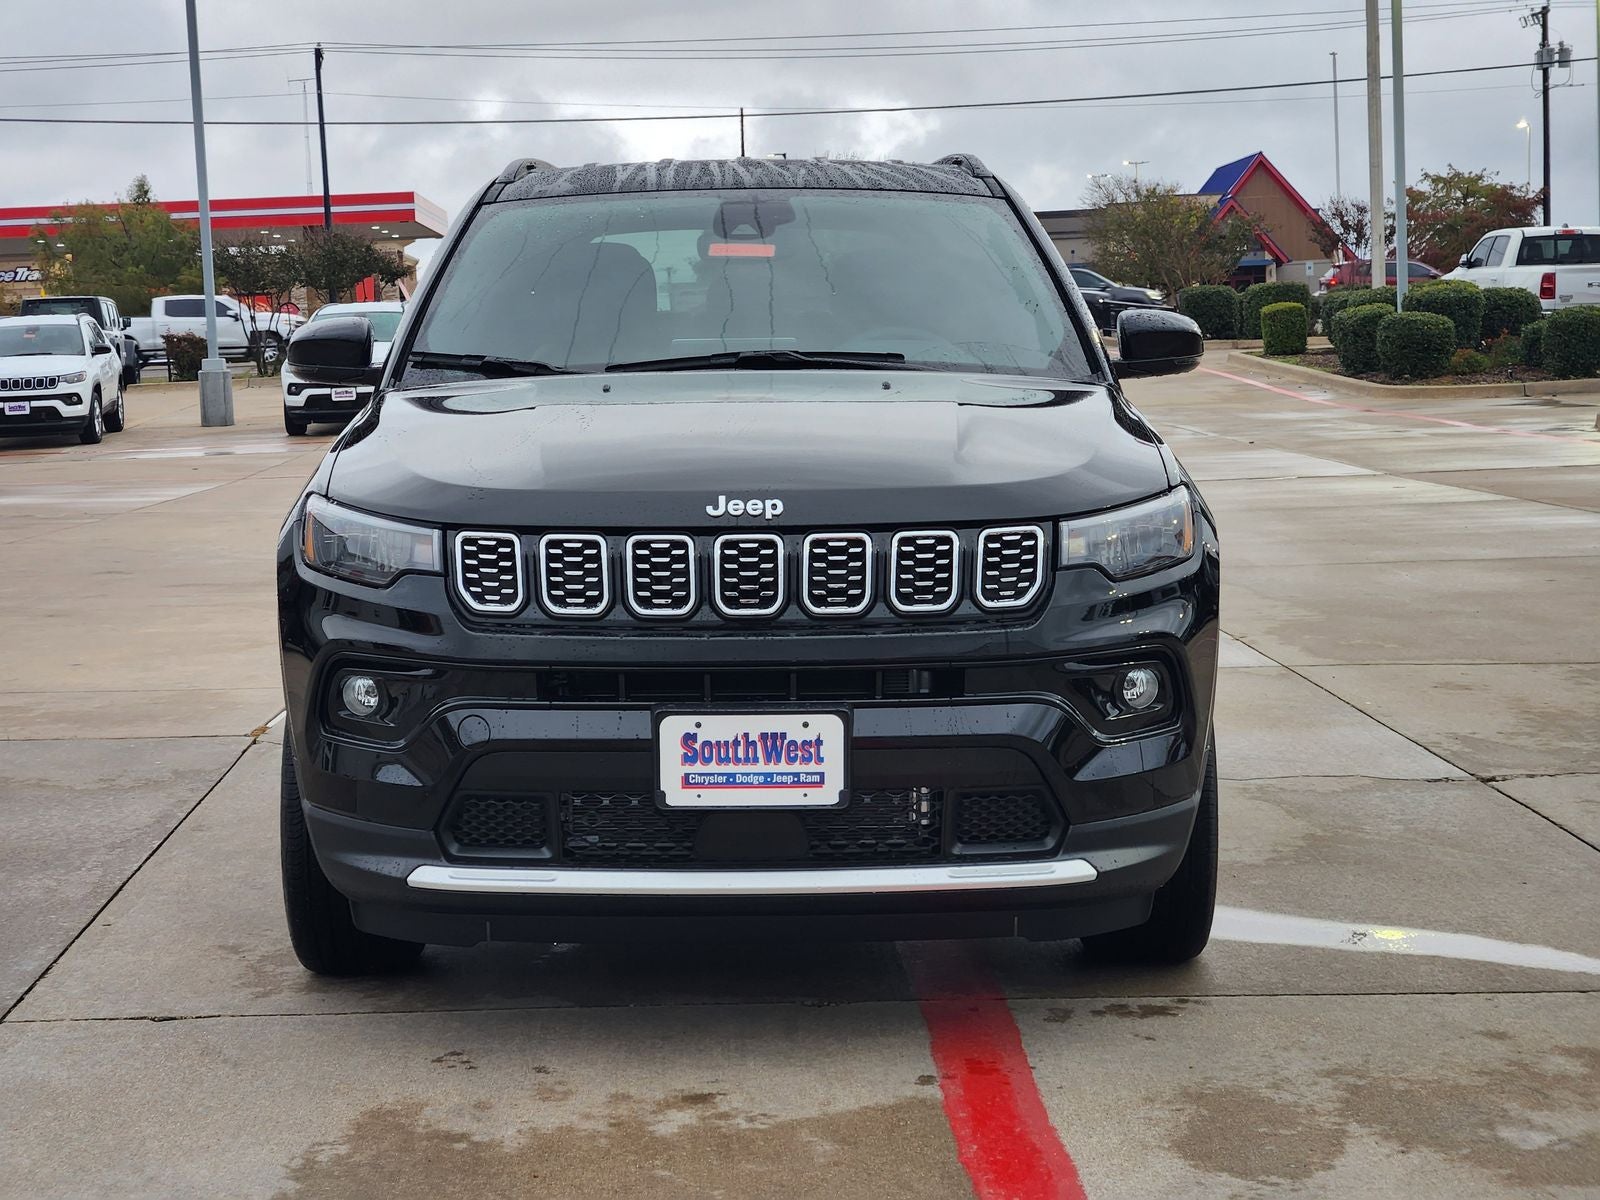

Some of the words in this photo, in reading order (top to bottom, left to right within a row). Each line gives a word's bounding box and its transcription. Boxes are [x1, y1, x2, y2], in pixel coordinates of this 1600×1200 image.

[705, 495, 784, 520] Jeep
[680, 732, 825, 767] SouthWest
[688, 773, 728, 785] Chrysler
[735, 773, 765, 785] Dodge
[771, 773, 794, 785] Jeep
[799, 773, 821, 784] Ram
